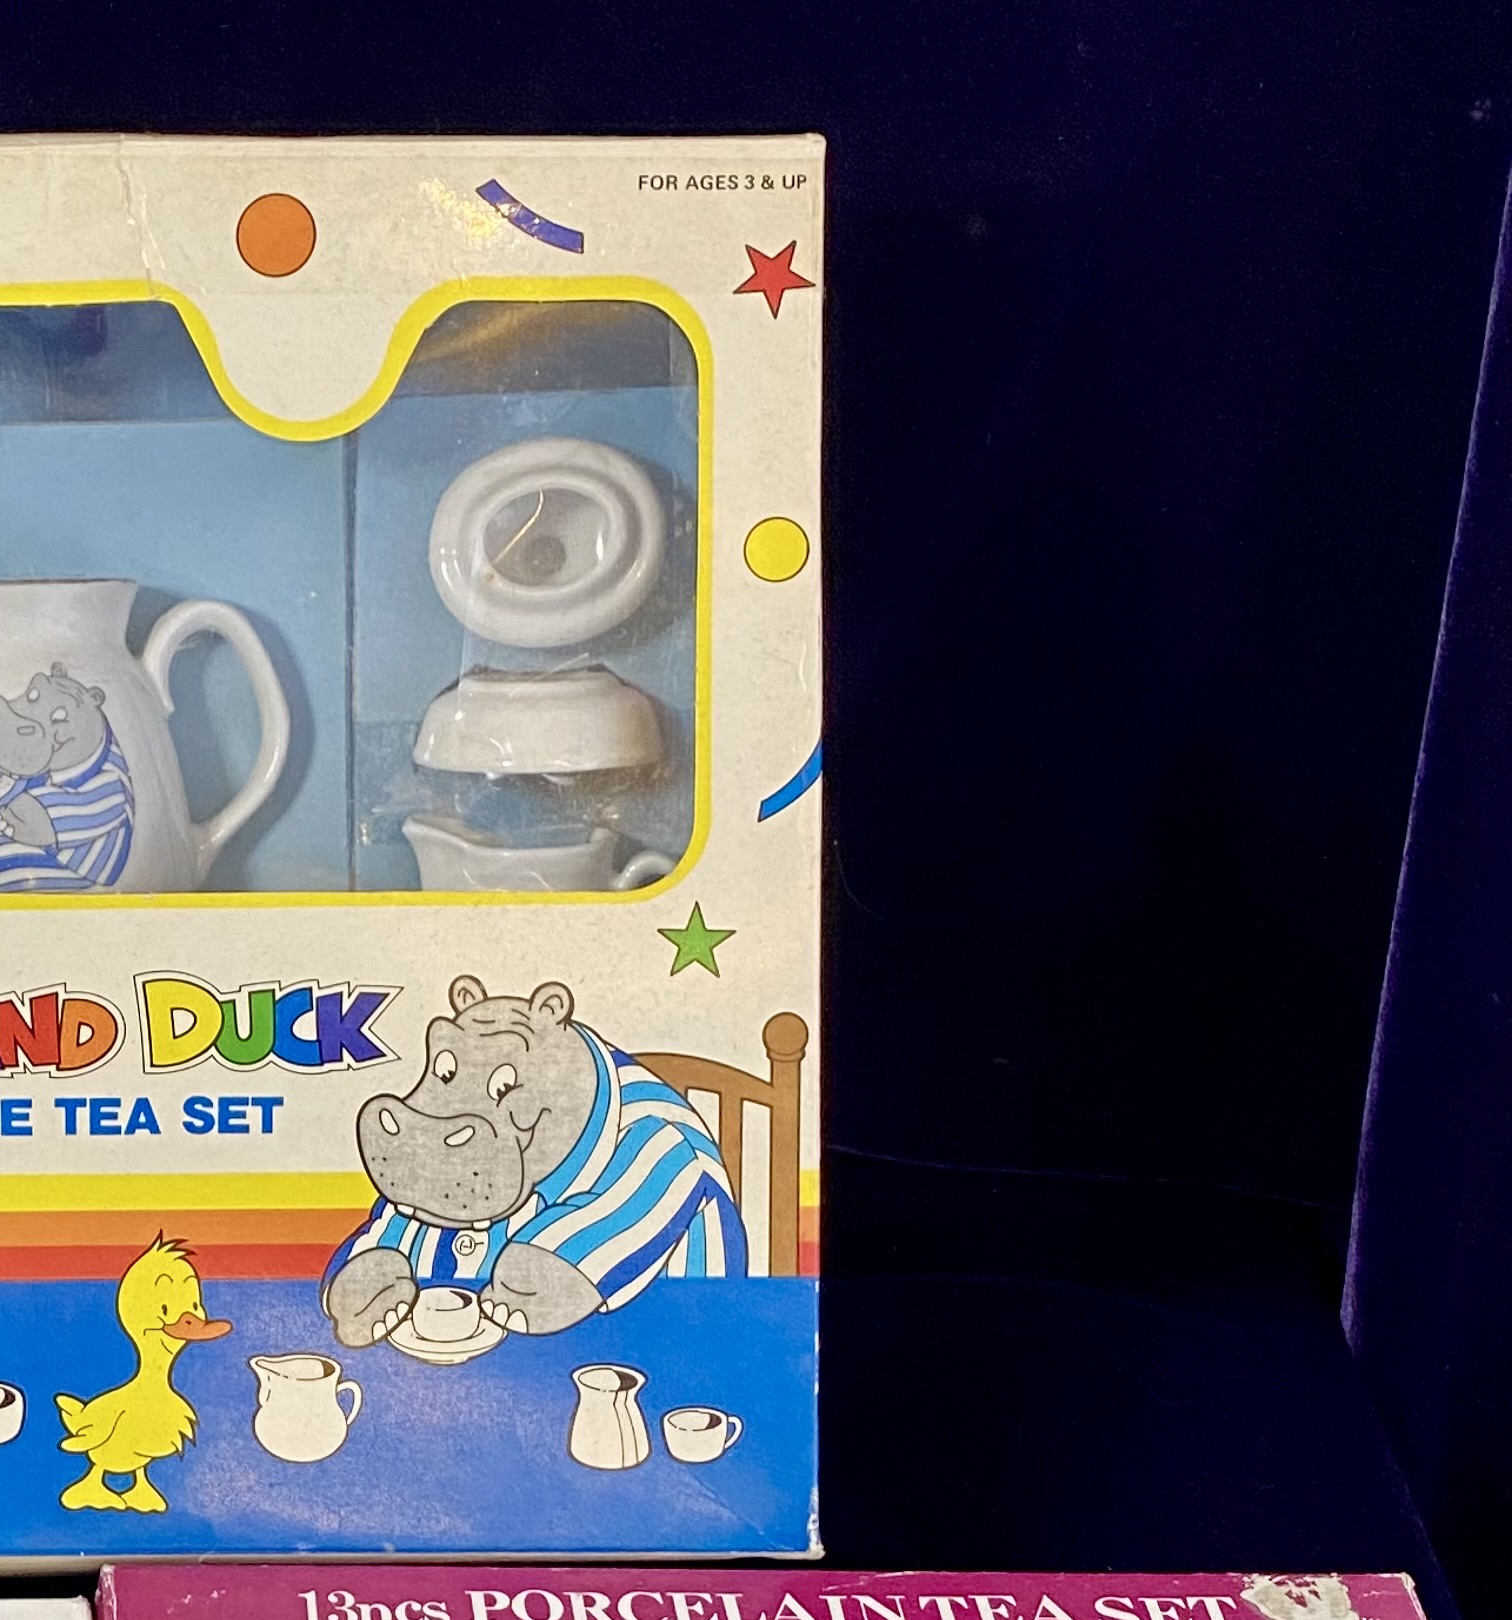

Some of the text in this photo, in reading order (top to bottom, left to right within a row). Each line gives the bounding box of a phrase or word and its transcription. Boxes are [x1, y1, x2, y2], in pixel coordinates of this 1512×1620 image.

[638, 174, 807, 190] FOR AGES 3 & UP
[142, 978, 388, 1068] DUCK
[54, 1097, 161, 1135] TEA
[183, 1096, 284, 1134] SET
